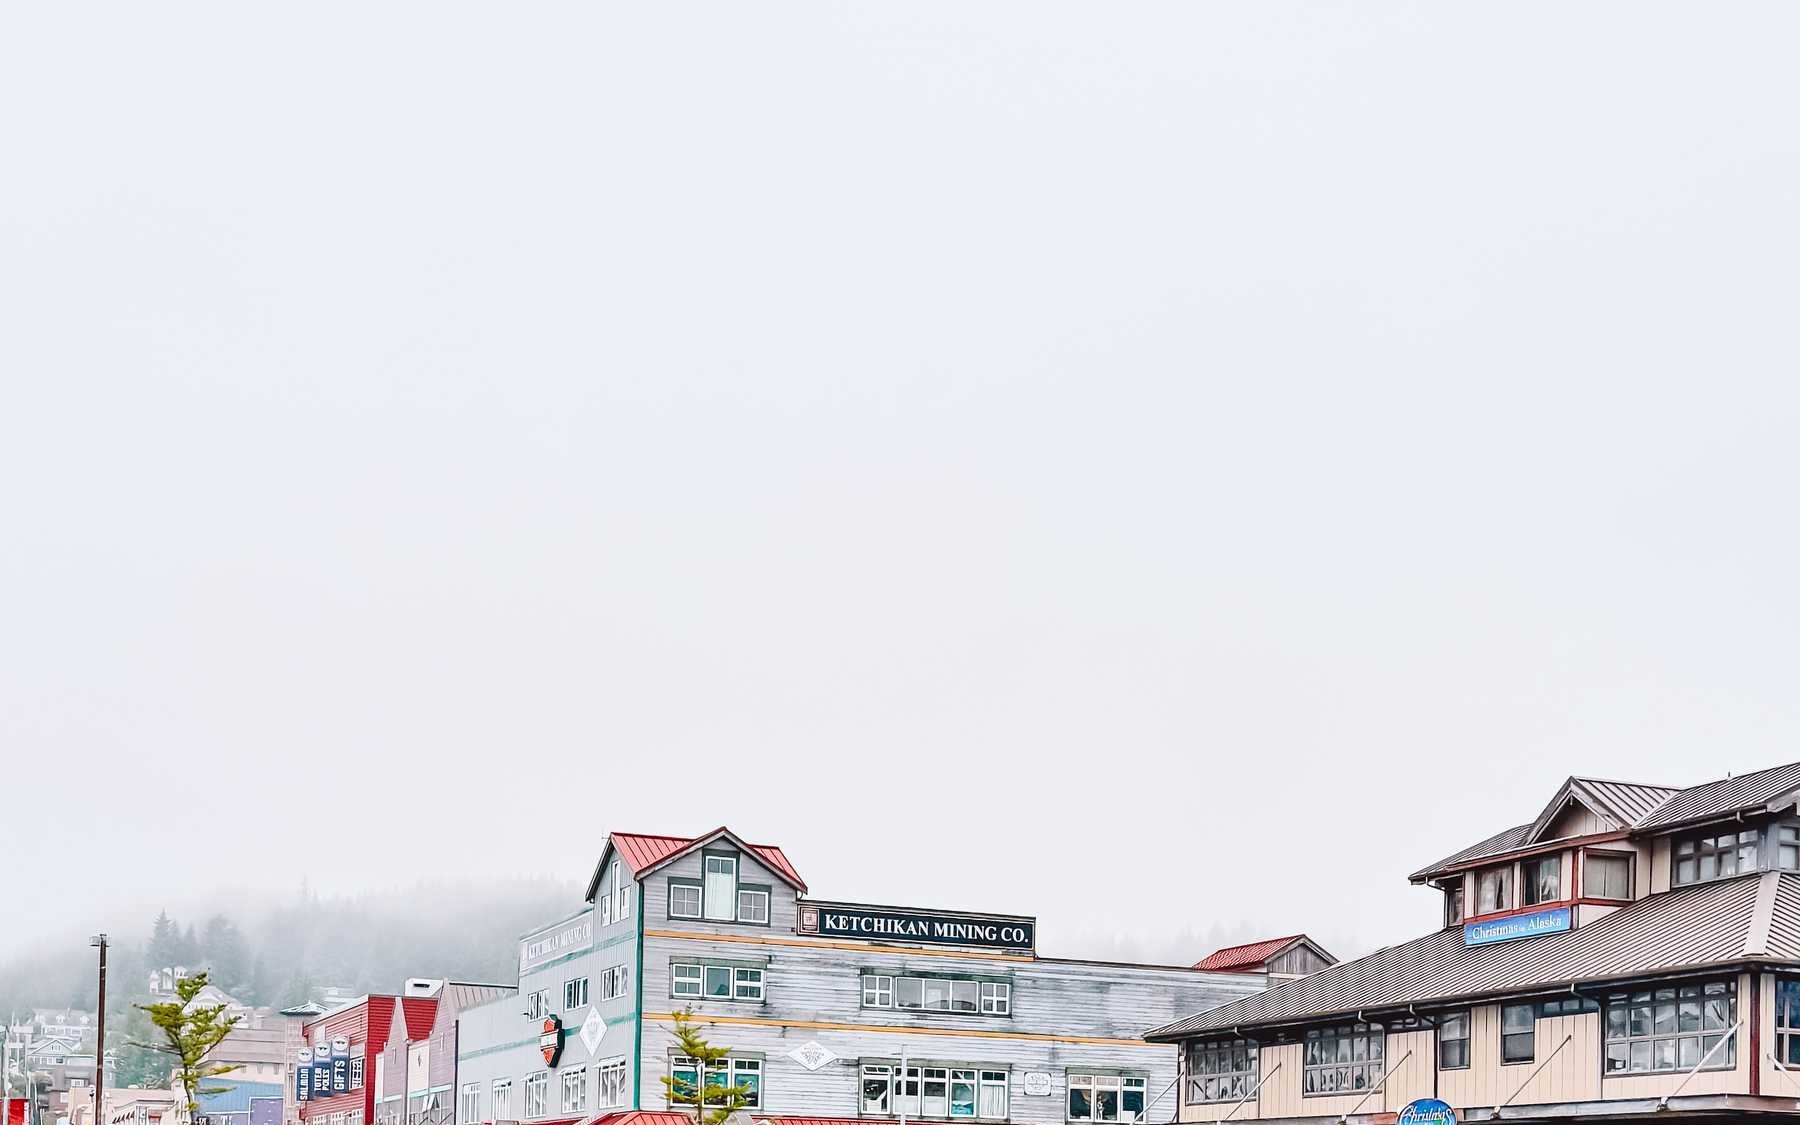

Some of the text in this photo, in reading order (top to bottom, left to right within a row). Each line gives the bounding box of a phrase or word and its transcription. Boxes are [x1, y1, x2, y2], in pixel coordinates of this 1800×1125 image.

[825, 913, 1029, 944] KETCHIKAN MINING CO.
[1472, 922, 1518, 939] Christmas
[1528, 914, 1562, 930] Alaska
[334, 1060, 346, 1090] GIFTS
